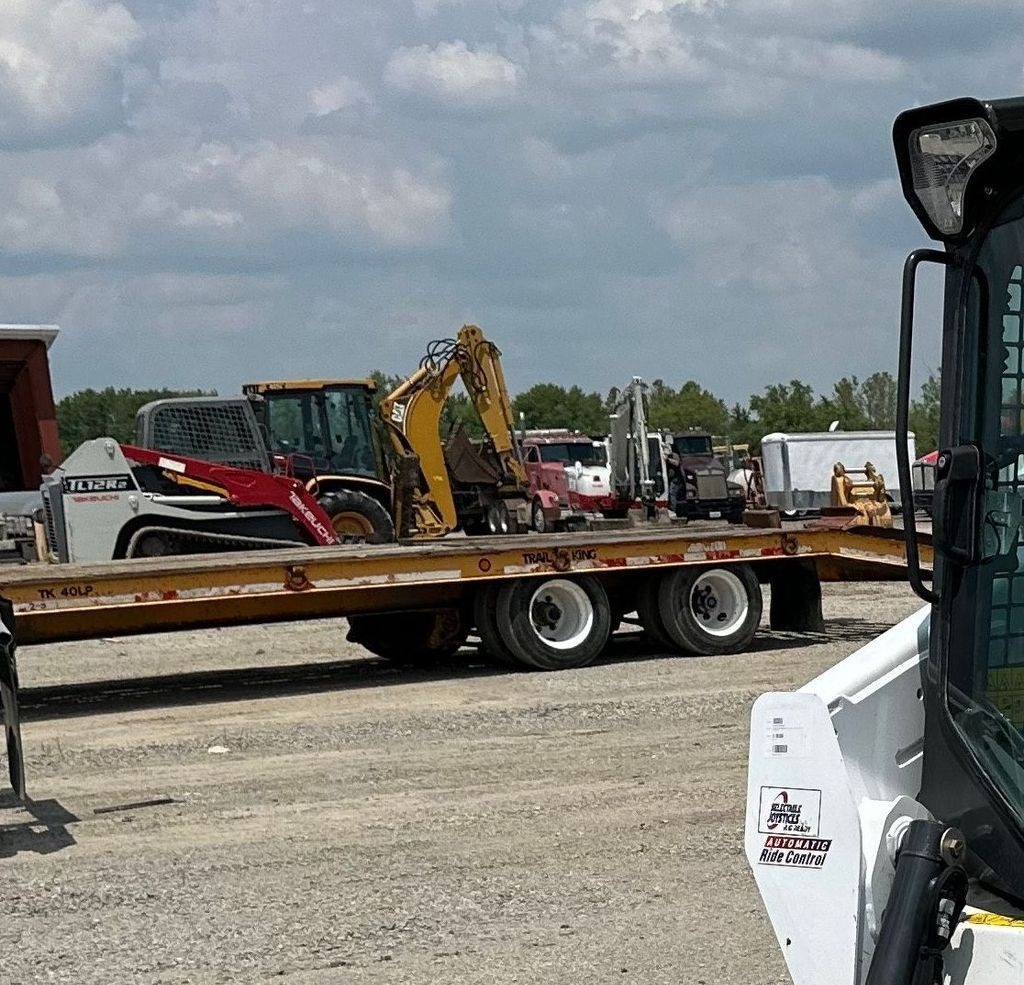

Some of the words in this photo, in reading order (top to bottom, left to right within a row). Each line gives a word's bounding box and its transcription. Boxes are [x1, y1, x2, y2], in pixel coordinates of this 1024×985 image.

[391, 401, 406, 423] CAT
[288, 490, 335, 545] TAKEUCHI
[521, 551, 553, 565] TRAIL
[571, 547, 597, 562] KING
[38, 588, 57, 599] TK
[60, 585, 94, 597] 40LP
[765, 836, 829, 852] AUTOMATIC
[759, 848, 785, 863] Ride
[785, 850, 828, 867] Control
